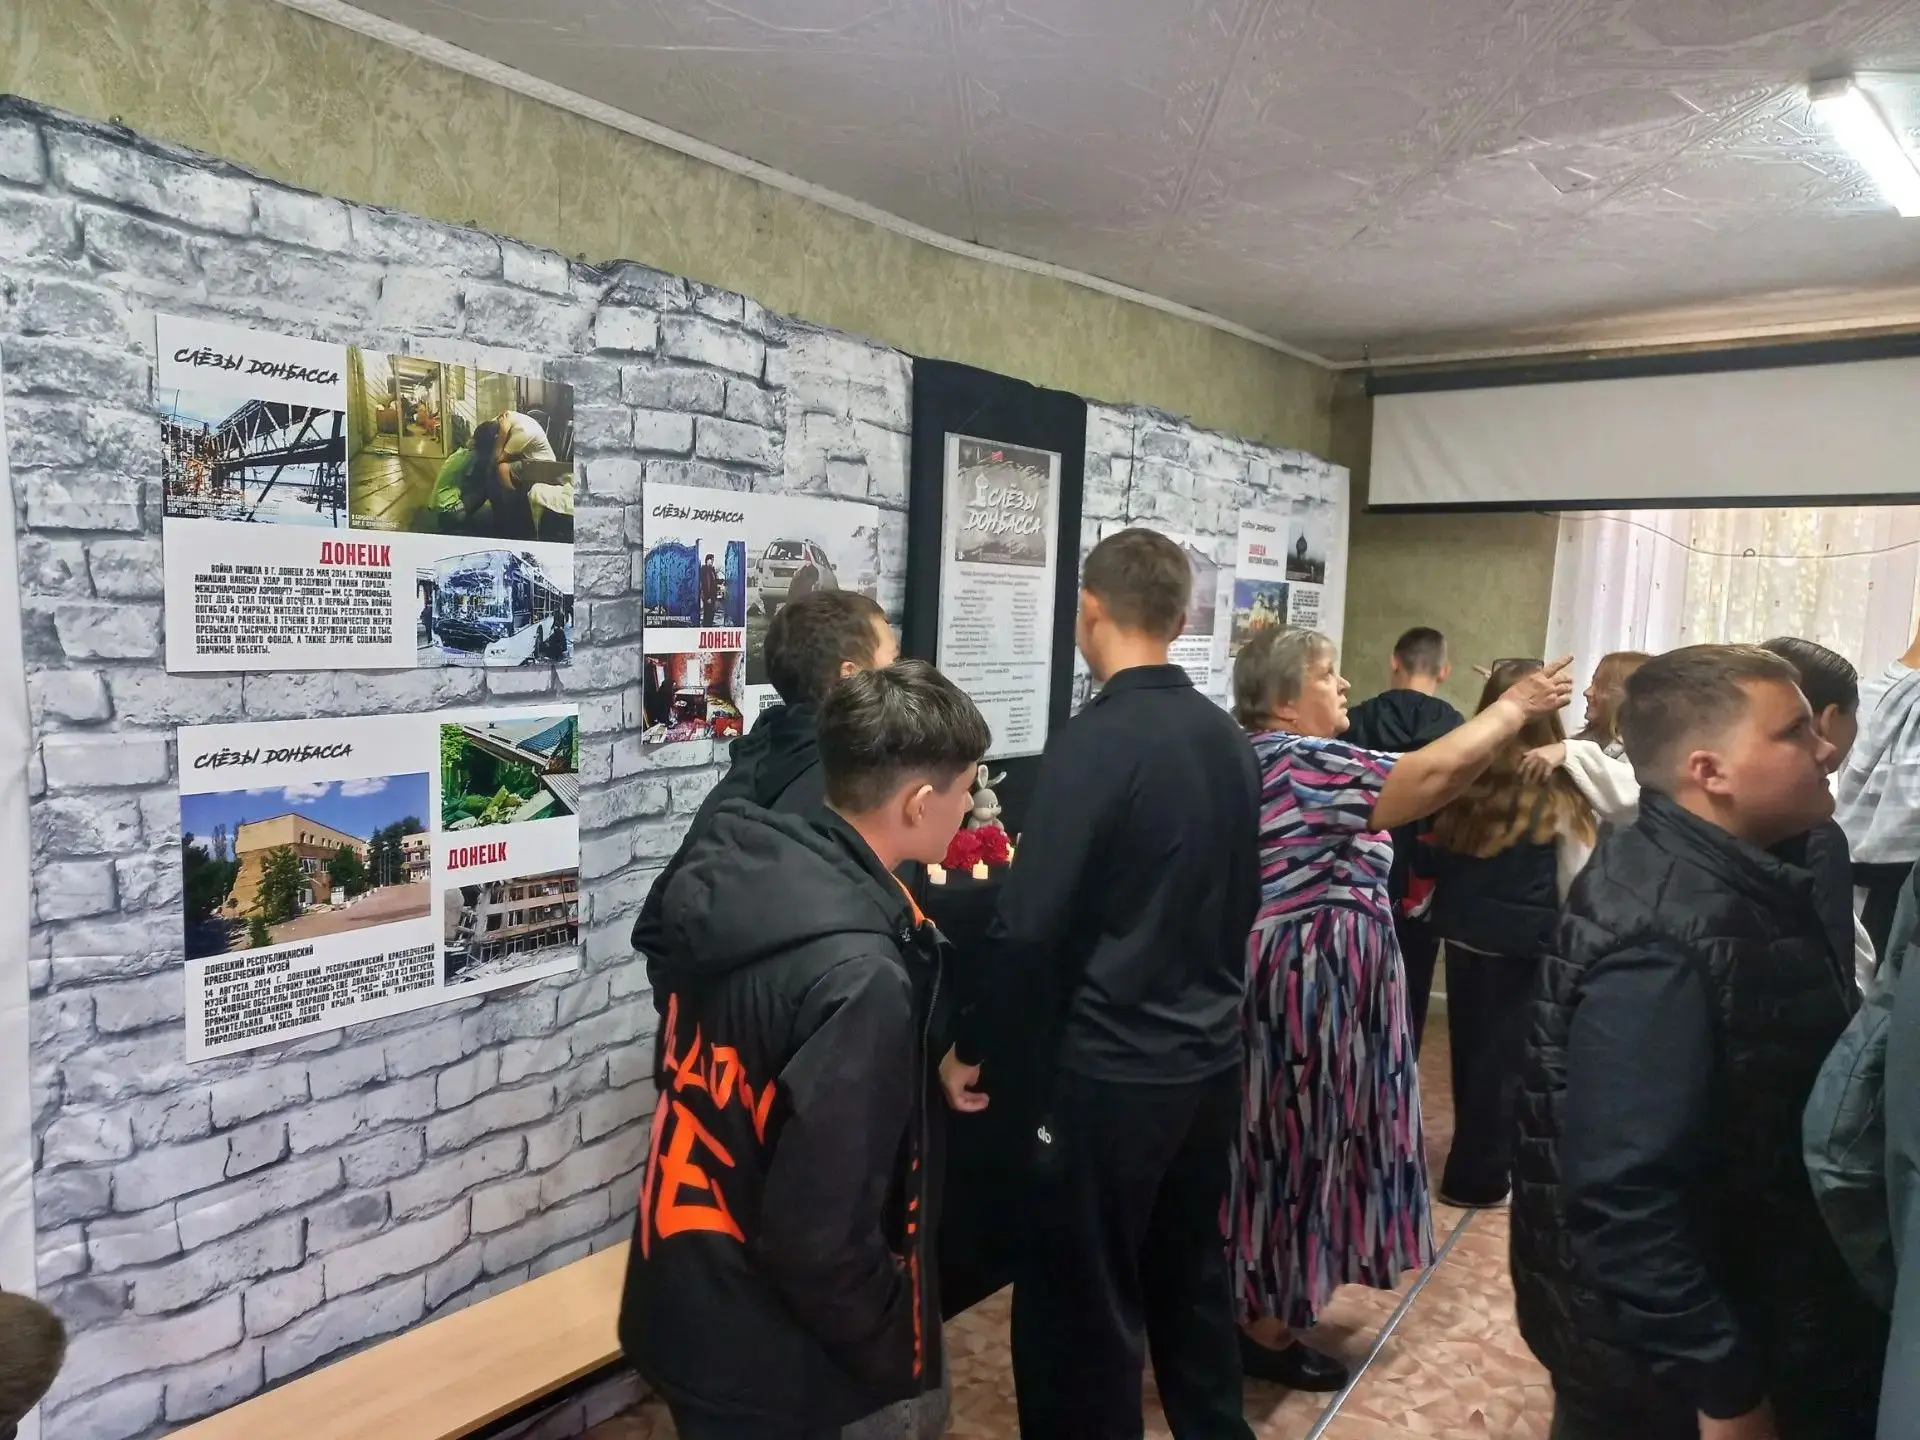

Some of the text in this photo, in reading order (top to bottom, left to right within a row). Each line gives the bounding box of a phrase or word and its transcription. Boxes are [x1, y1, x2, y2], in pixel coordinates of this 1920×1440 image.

[174, 347, 339, 385] СЛЁЗЫ ДОНБАССА
[988, 481, 1039, 511] СЛЁЗЫ
[653, 503, 744, 523] СЛЁЗЫ ДОНБАССА
[964, 507, 1041, 535] ДОНБАССА
[320, 542, 390, 566] ДОНЕЦК
[195, 575, 226, 583] АВИАЦИЯ
[230, 576, 260, 584] НАНЕСЛА
[263, 577, 280, 585] УДАР
[362, 580, 385, 588] ГОРОДА
[211, 563, 232, 573] ВОЙНА
[278, 567, 303, 576] ДОНЕЦК
[317, 569, 329, 577] МАЯ
[355, 570, 392, 579] УКРАИНСКАЯ
[195, 584, 257, 594] МЕЖДУНАРОДНОМУ
[259, 586, 293, 595] АЭРОПОРТУ
[195, 595, 212, 603] ЭТОТ
[216, 595, 234, 604] ДЕНЬ
[238, 596, 254, 604] СТАЛ
[259, 596, 283, 604] ТОЧКОЙ
[325, 597, 350, 606] ПЕРВЫЙ
[353, 598, 369, 606] ДЕНЬ
[372, 597, 392, 606] ВОЙНЫ
[196, 605, 227, 613] ПОГИБЛО
[230, 605, 239, 614] 40
[242, 606, 270, 614] МИРНЫХ
[274, 606, 304, 615] ЖИТЕЛЕЙ
[307, 608, 338, 616] СТОЛИЦЫ
[196, 615, 234, 624] ПОЛУЧИЛИ
[332, 617, 370, 625] КОЛИЧЕСТВО
[196, 625, 238, 634] ПРЕВЫСИЛО
[240, 625, 277, 634] ТЫСЯЧНУЮ
[311, 626, 347, 634] РАЗРУШЕНО
[196, 635, 231, 644] ОБЪЕКТОВ
[330, 636, 354, 644] ДРУГИЕ
[699, 631, 741, 648] ДОНЕЦК
[196, 646, 234, 654] ЗНАЧИМЫЕ
[194, 743, 353, 770] СЛЁЗЫ ДОНБАССА
[447, 842, 506, 870] ДОНЕЦК
[204, 945, 314, 975] ДОНЕЦКИЙ РЕСПУБЛИКАНСКИЙ
[205, 990, 213, 998] 14
[220, 982, 248, 996] АВГУСТА
[254, 978, 271, 988] 2014
[287, 966, 321, 982] ДОНЕЦКИЙ
[326, 953, 383, 974] РЕСПУБЛИКАНСКИЙ
[389, 943, 434, 960] КРАЕВЕДЧЕСКИЙ
[204, 960, 290, 986] КРАЕВЕДЧЕСКИЙ МУЗЕЙ
[205, 953, 434, 1008] МУЗЕЙ ПОДВЕРГСЯ ПЕРВОМУ МАССИРОВАННОМУ ОБСТРЕЛУ АРТИЛЛЕРИИ
[205, 1013, 239, 1027] ПРЯМЫМИ
[243, 1001, 292, 1019] ПОПАДАНИЯМИ
[296, 993, 329, 1007] СНАРЯДОВ
[382, 978, 399, 988] БЫЛА
[402, 970, 434, 984] РАЗРУШЕНА
[222, 1001, 251, 1013] МОЩНЫЕ
[254, 994, 288, 1007] ОБСТРЕЛЫ
[290, 984, 334, 999] ПОВТОРИЛИСЬ
[352, 973, 380, 986] ДВАЖДЫ
[205, 1017, 263, 1037] ЗНАЧИТЕЛЬНАЯ
[270, 1011, 292, 1022] ЧАСТЬ
[299, 1003, 324, 1016] ЛЕВОГО
[331, 997, 355, 1008] КРЫЛА
[394, 979, 434, 994] УНИЧТОЖЕНА
[205, 1022, 276, 1047] ПРИРОДОВЕДЧЕСКАЯ
